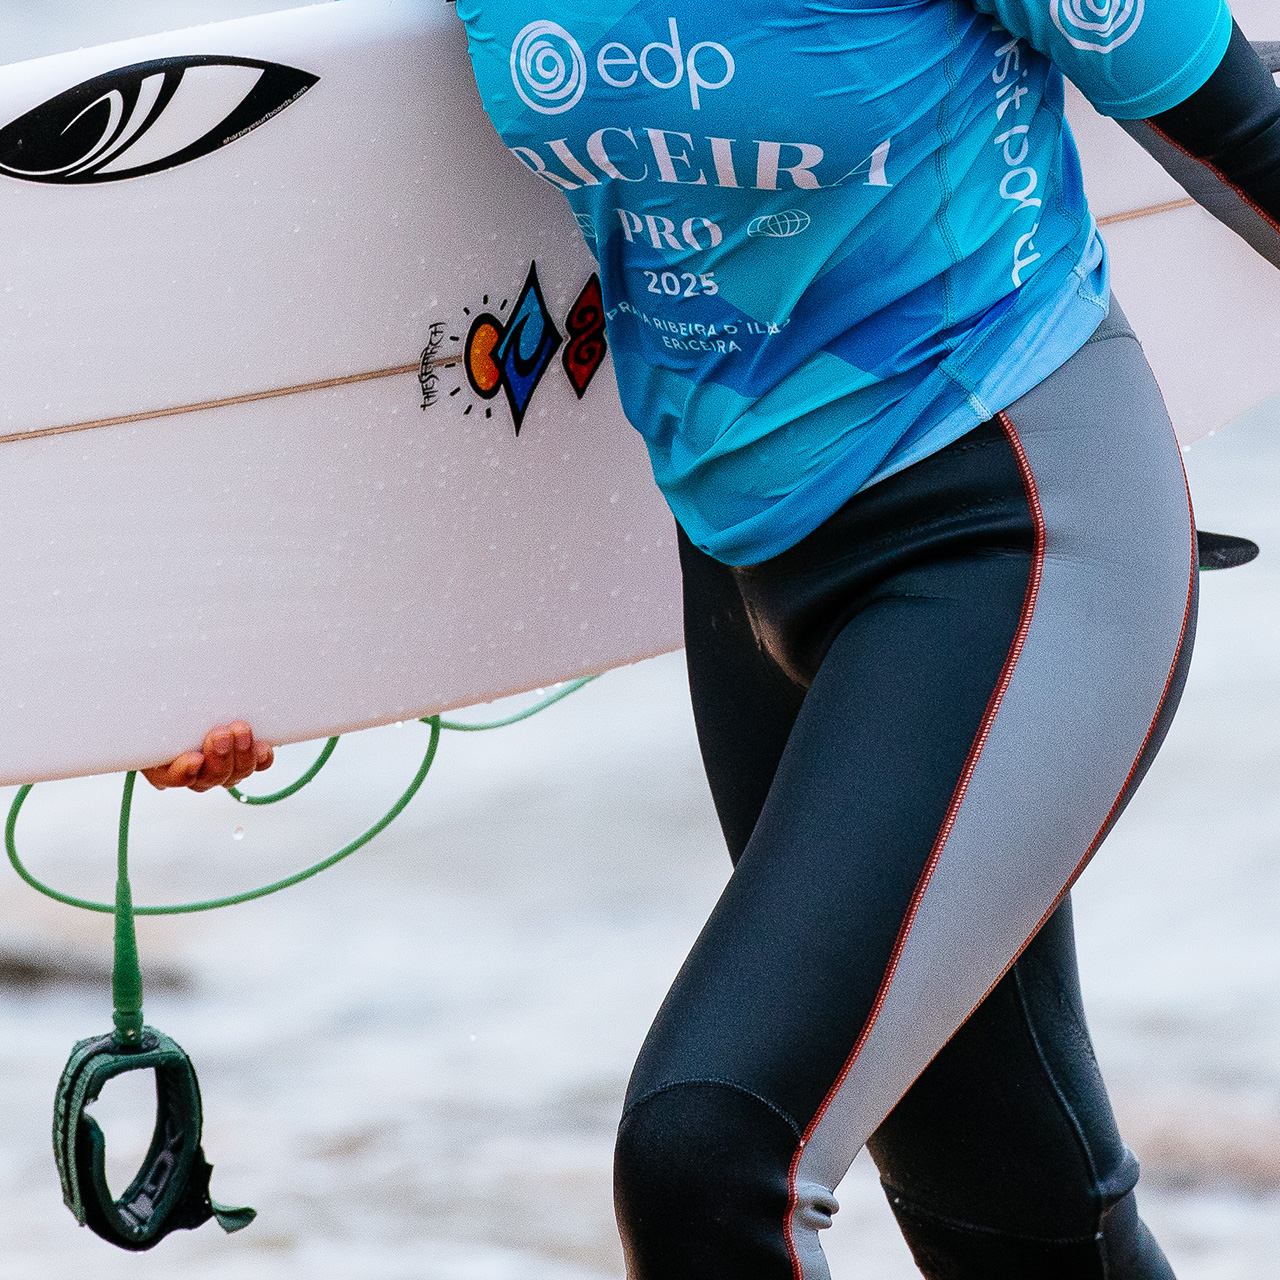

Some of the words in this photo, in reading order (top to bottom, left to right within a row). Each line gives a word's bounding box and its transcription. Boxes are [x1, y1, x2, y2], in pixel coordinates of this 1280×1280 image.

[597, 17, 735, 111] edp
[222, 85, 309, 145] sharpeyesurfboards.com
[615, 208, 723, 251] PRO
[644, 270, 719, 298] 2025
[653, 317, 719, 338] RIBEIRA
[662, 335, 742, 354] ERICEIRA
